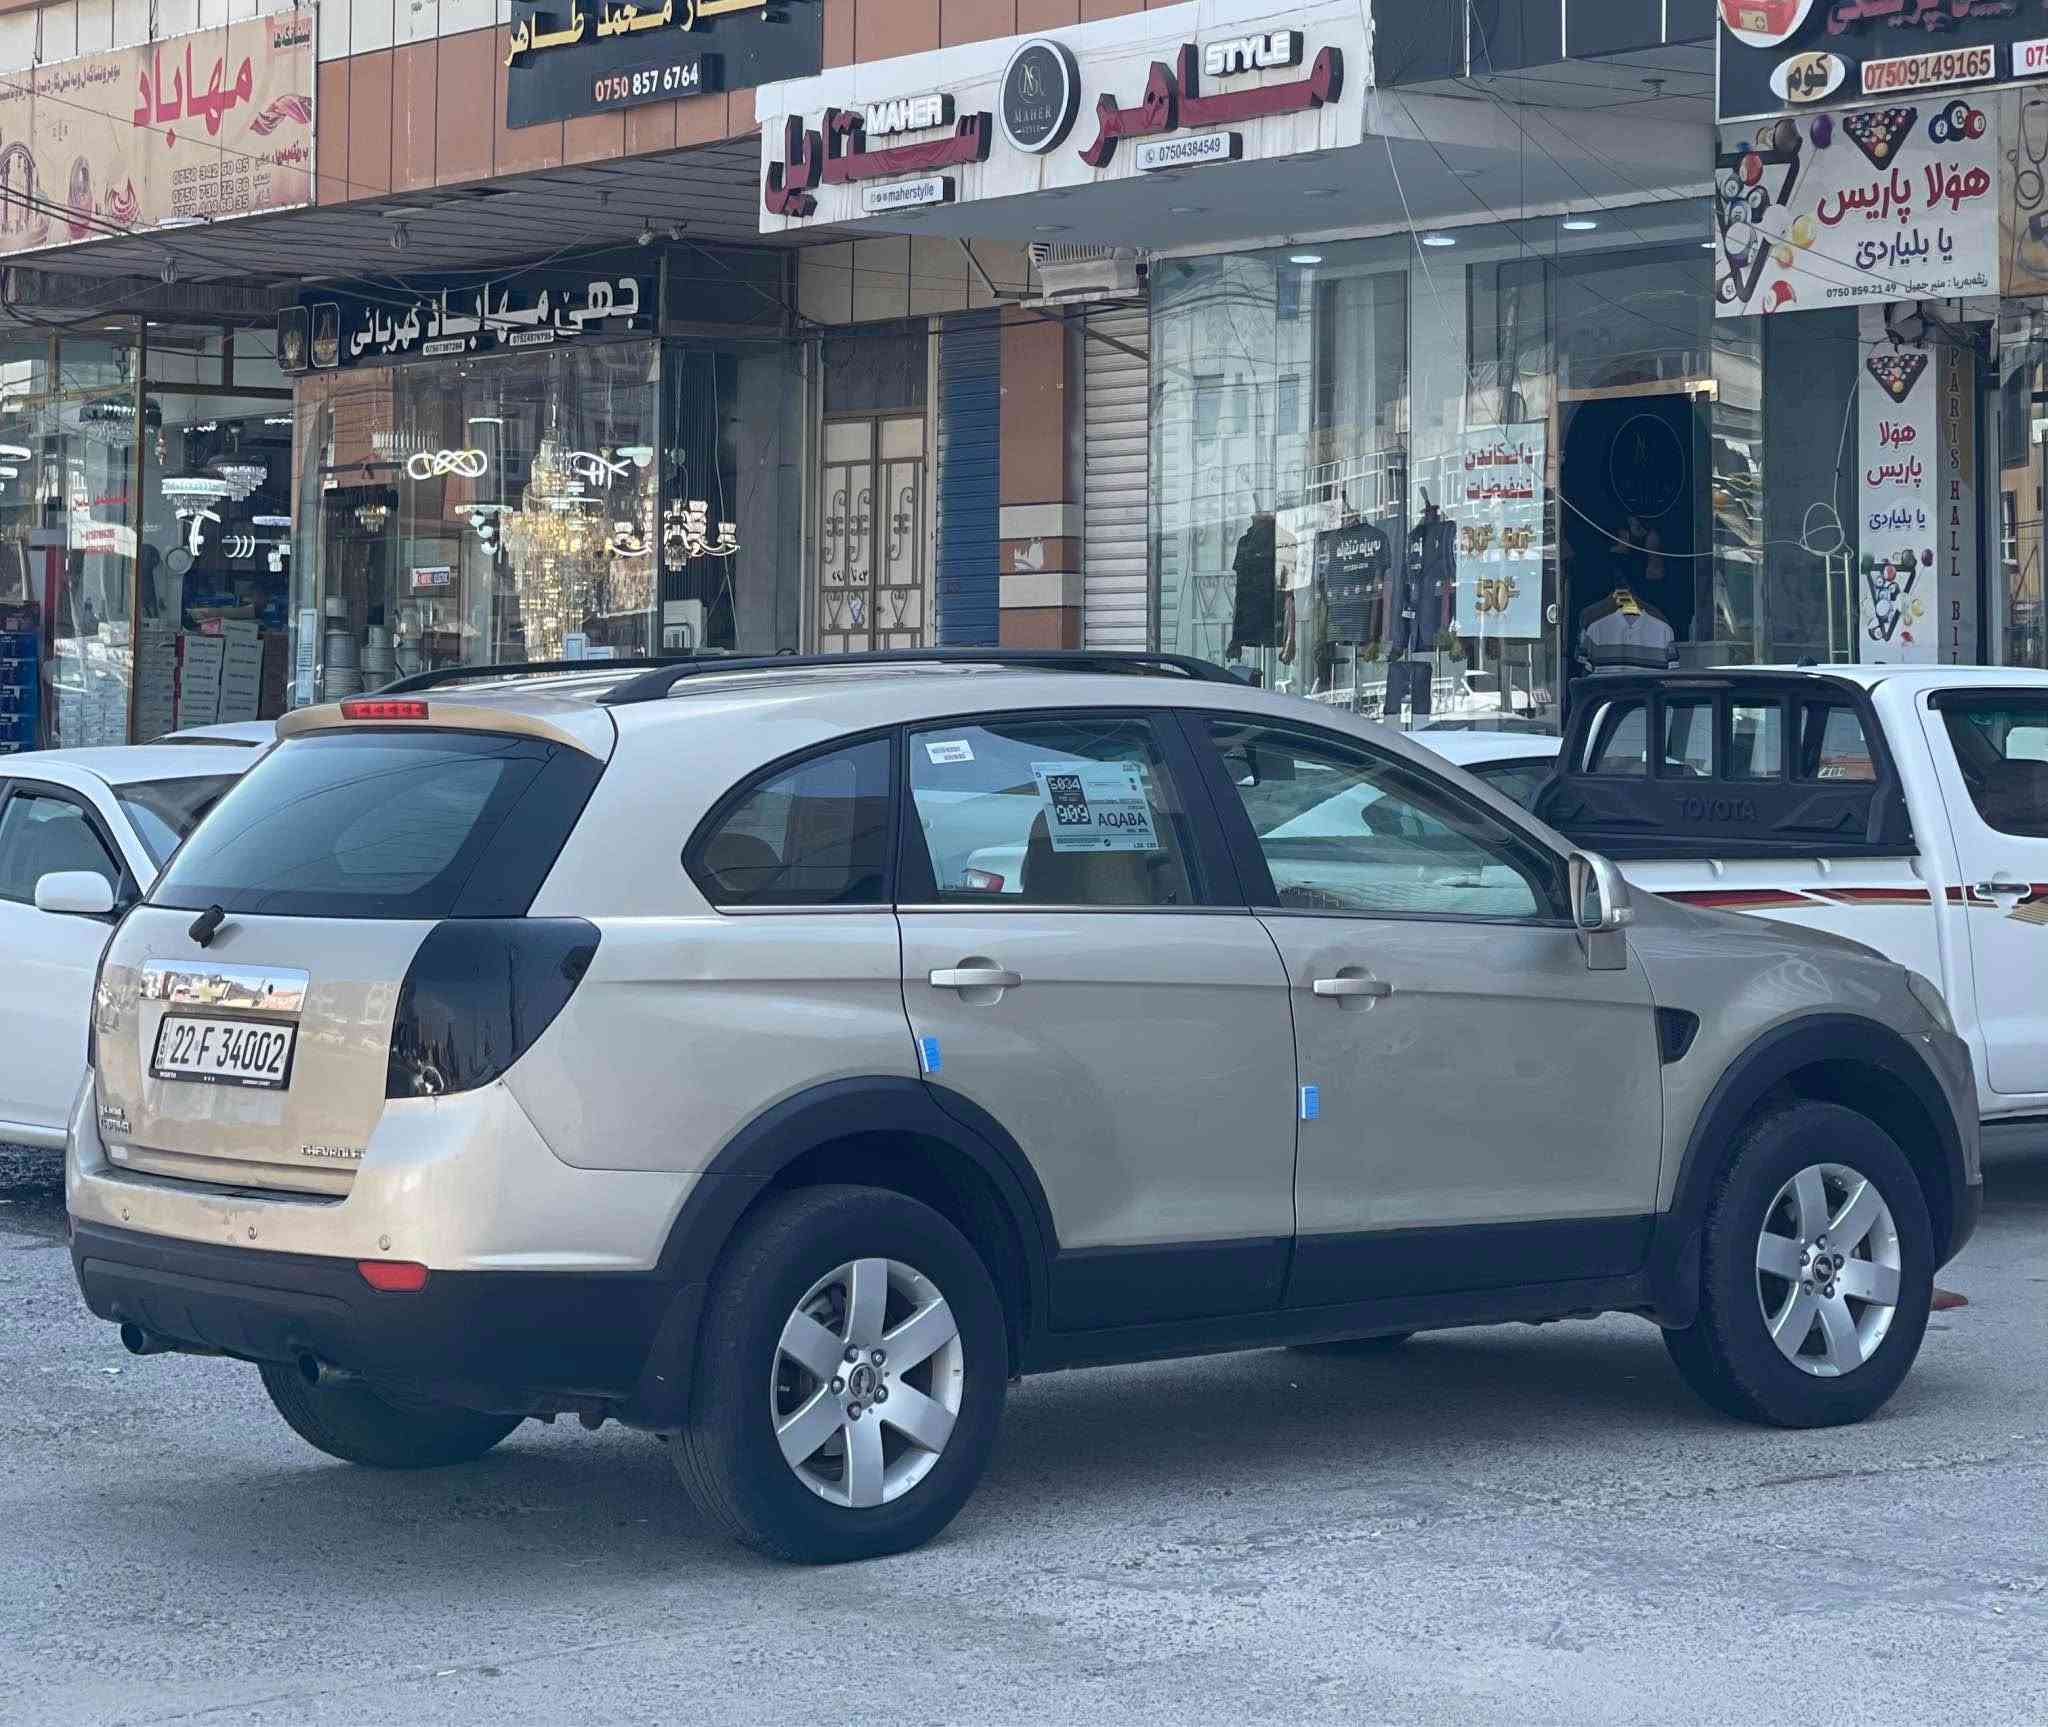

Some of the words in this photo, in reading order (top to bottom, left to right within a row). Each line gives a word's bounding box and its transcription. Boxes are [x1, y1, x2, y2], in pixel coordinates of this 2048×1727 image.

[1205, 31, 1292, 76] STYLE
[1864, 49, 1992, 91] 07509149165
[133, 41, 254, 148] مهاباد
[595, 78, 629, 102] 0750
[632, 70, 659, 96] 857
[663, 62, 699, 89] 6764
[866, 94, 943, 136] MAHER
[1079, 43, 1344, 168] ماهر
[1160, 138, 1221, 161] 07504384549
[1826, 287, 1850, 298] 0750
[1949, 349, 1961, 470] PARIS
[1948, 479, 1961, 577] HALL
[1098, 812, 1149, 828] AQABA
[1676, 798, 1757, 822] TOYOTA
[170, 1025, 196, 1065] 22
[197, 1026, 215, 1066] F
[216, 1027, 286, 1074] 34002
